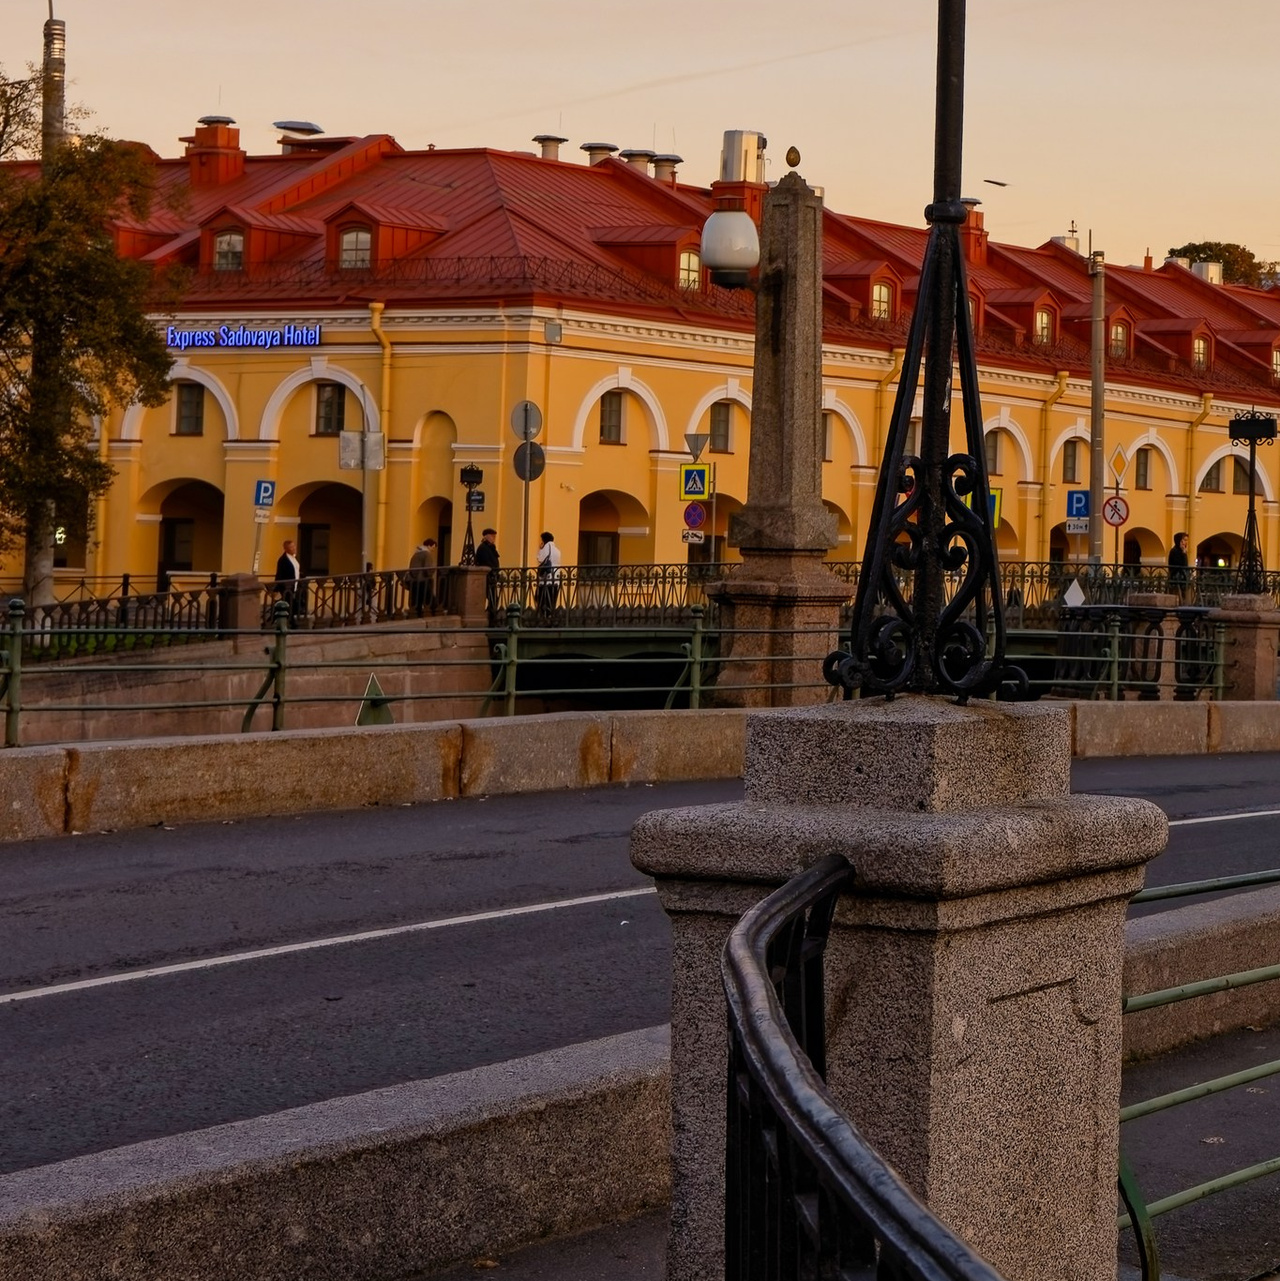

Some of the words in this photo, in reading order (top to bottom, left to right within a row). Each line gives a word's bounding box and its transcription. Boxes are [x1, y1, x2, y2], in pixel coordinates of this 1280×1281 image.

[167, 326, 216, 350] Express
[219, 325, 281, 349] Sadovaya
[284, 324, 320, 346] Hotel
[259, 482, 272, 504] P
[1073, 493, 1086, 515] P
